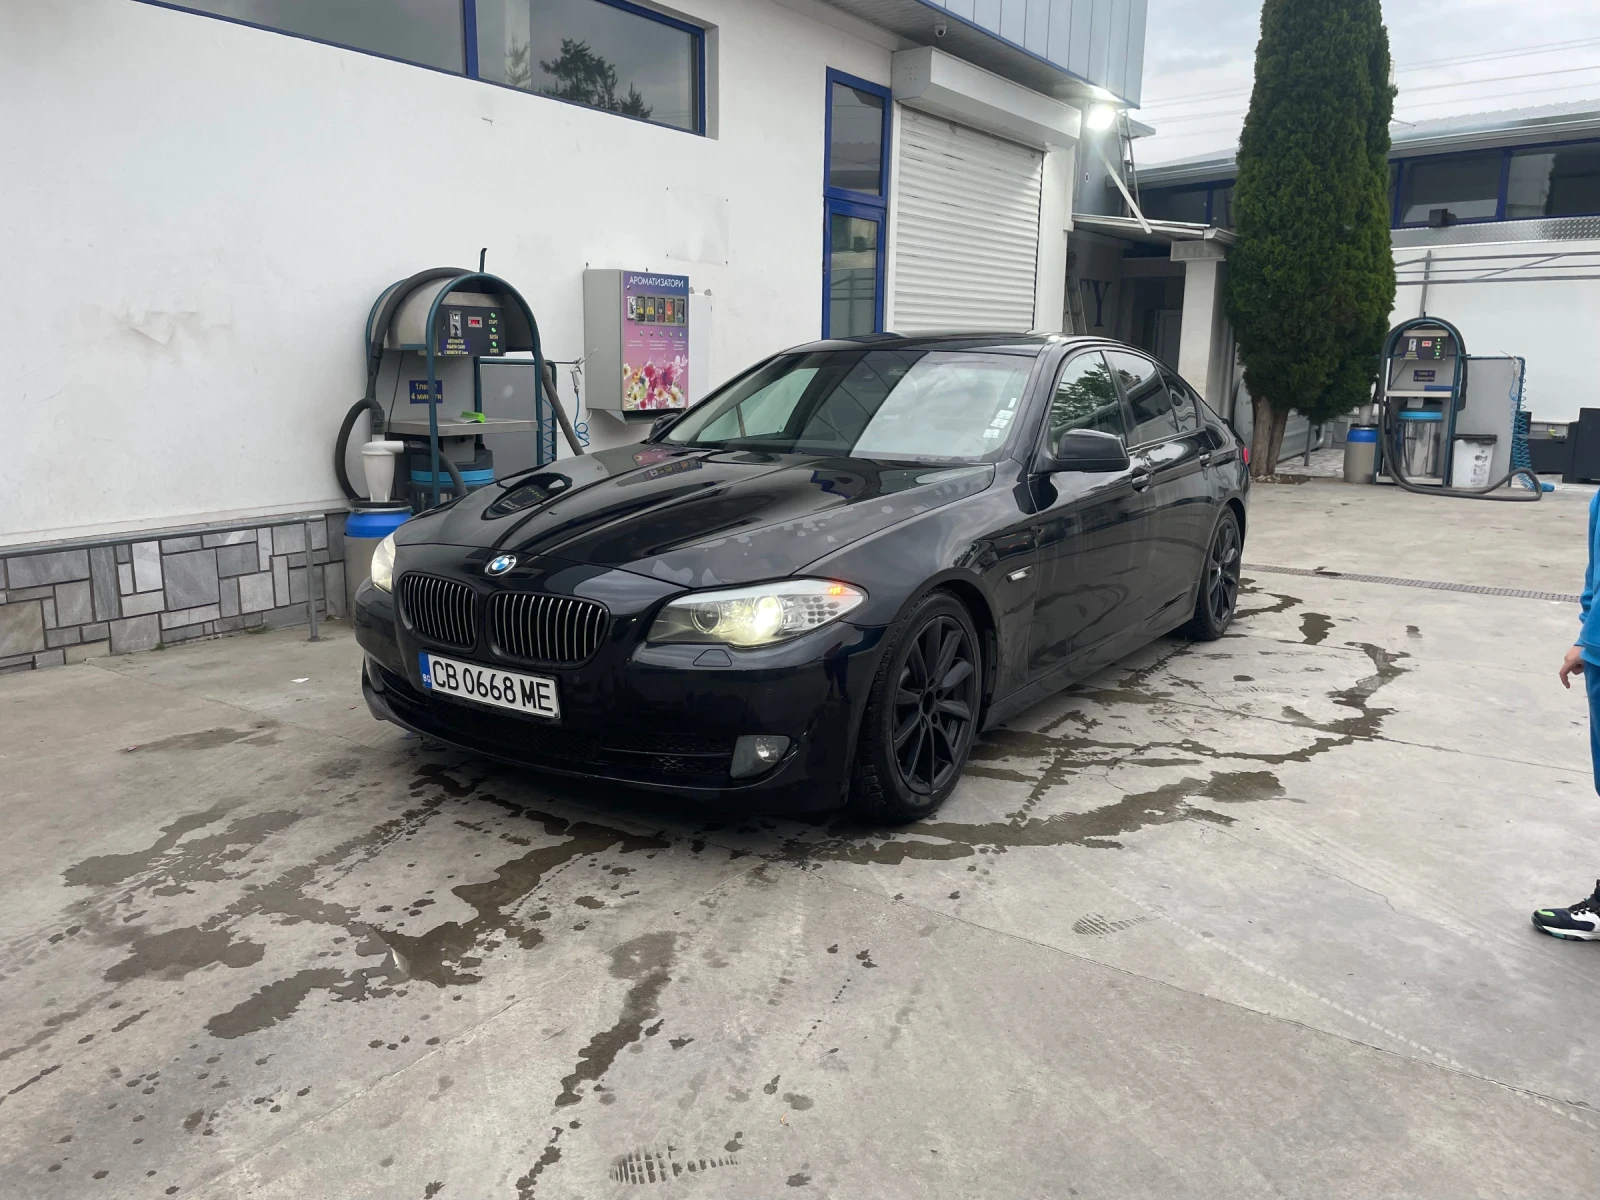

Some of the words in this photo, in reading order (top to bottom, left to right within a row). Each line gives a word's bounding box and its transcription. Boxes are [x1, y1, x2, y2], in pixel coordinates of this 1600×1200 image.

[628, 275, 684, 288] АРОМАТИЗАТОРИ
[411, 392, 416, 400] 4
[422, 673, 431, 683] BG
[463, 667, 516, 704] 0668
[520, 678, 553, 712] ME
